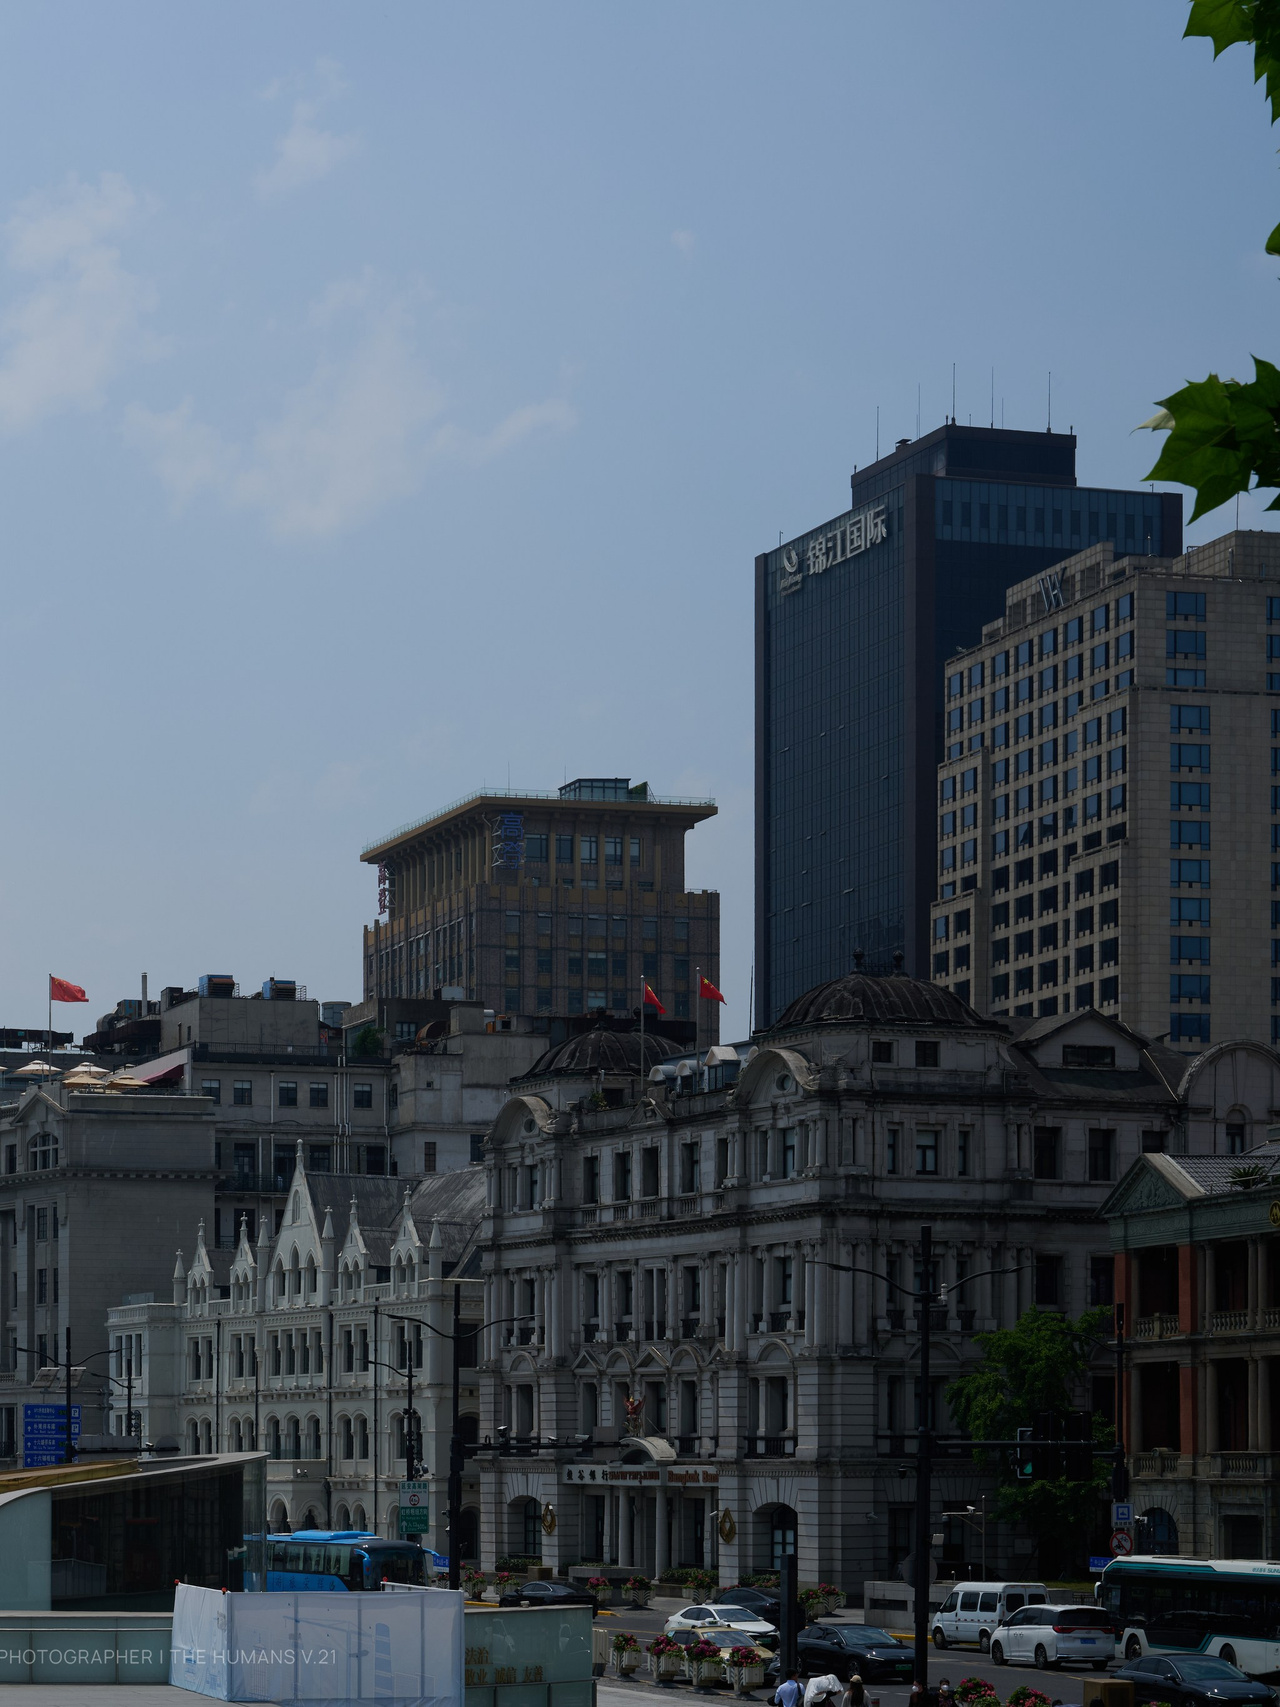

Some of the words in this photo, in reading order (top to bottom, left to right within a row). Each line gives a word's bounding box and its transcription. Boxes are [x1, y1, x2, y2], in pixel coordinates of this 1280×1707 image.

[807, 505, 887, 576] 锦江国际
[500, 812, 524, 871] 高登
[668, 1470, 700, 1485] Bangkok
[524, 1665, 544, 1683] 友善
